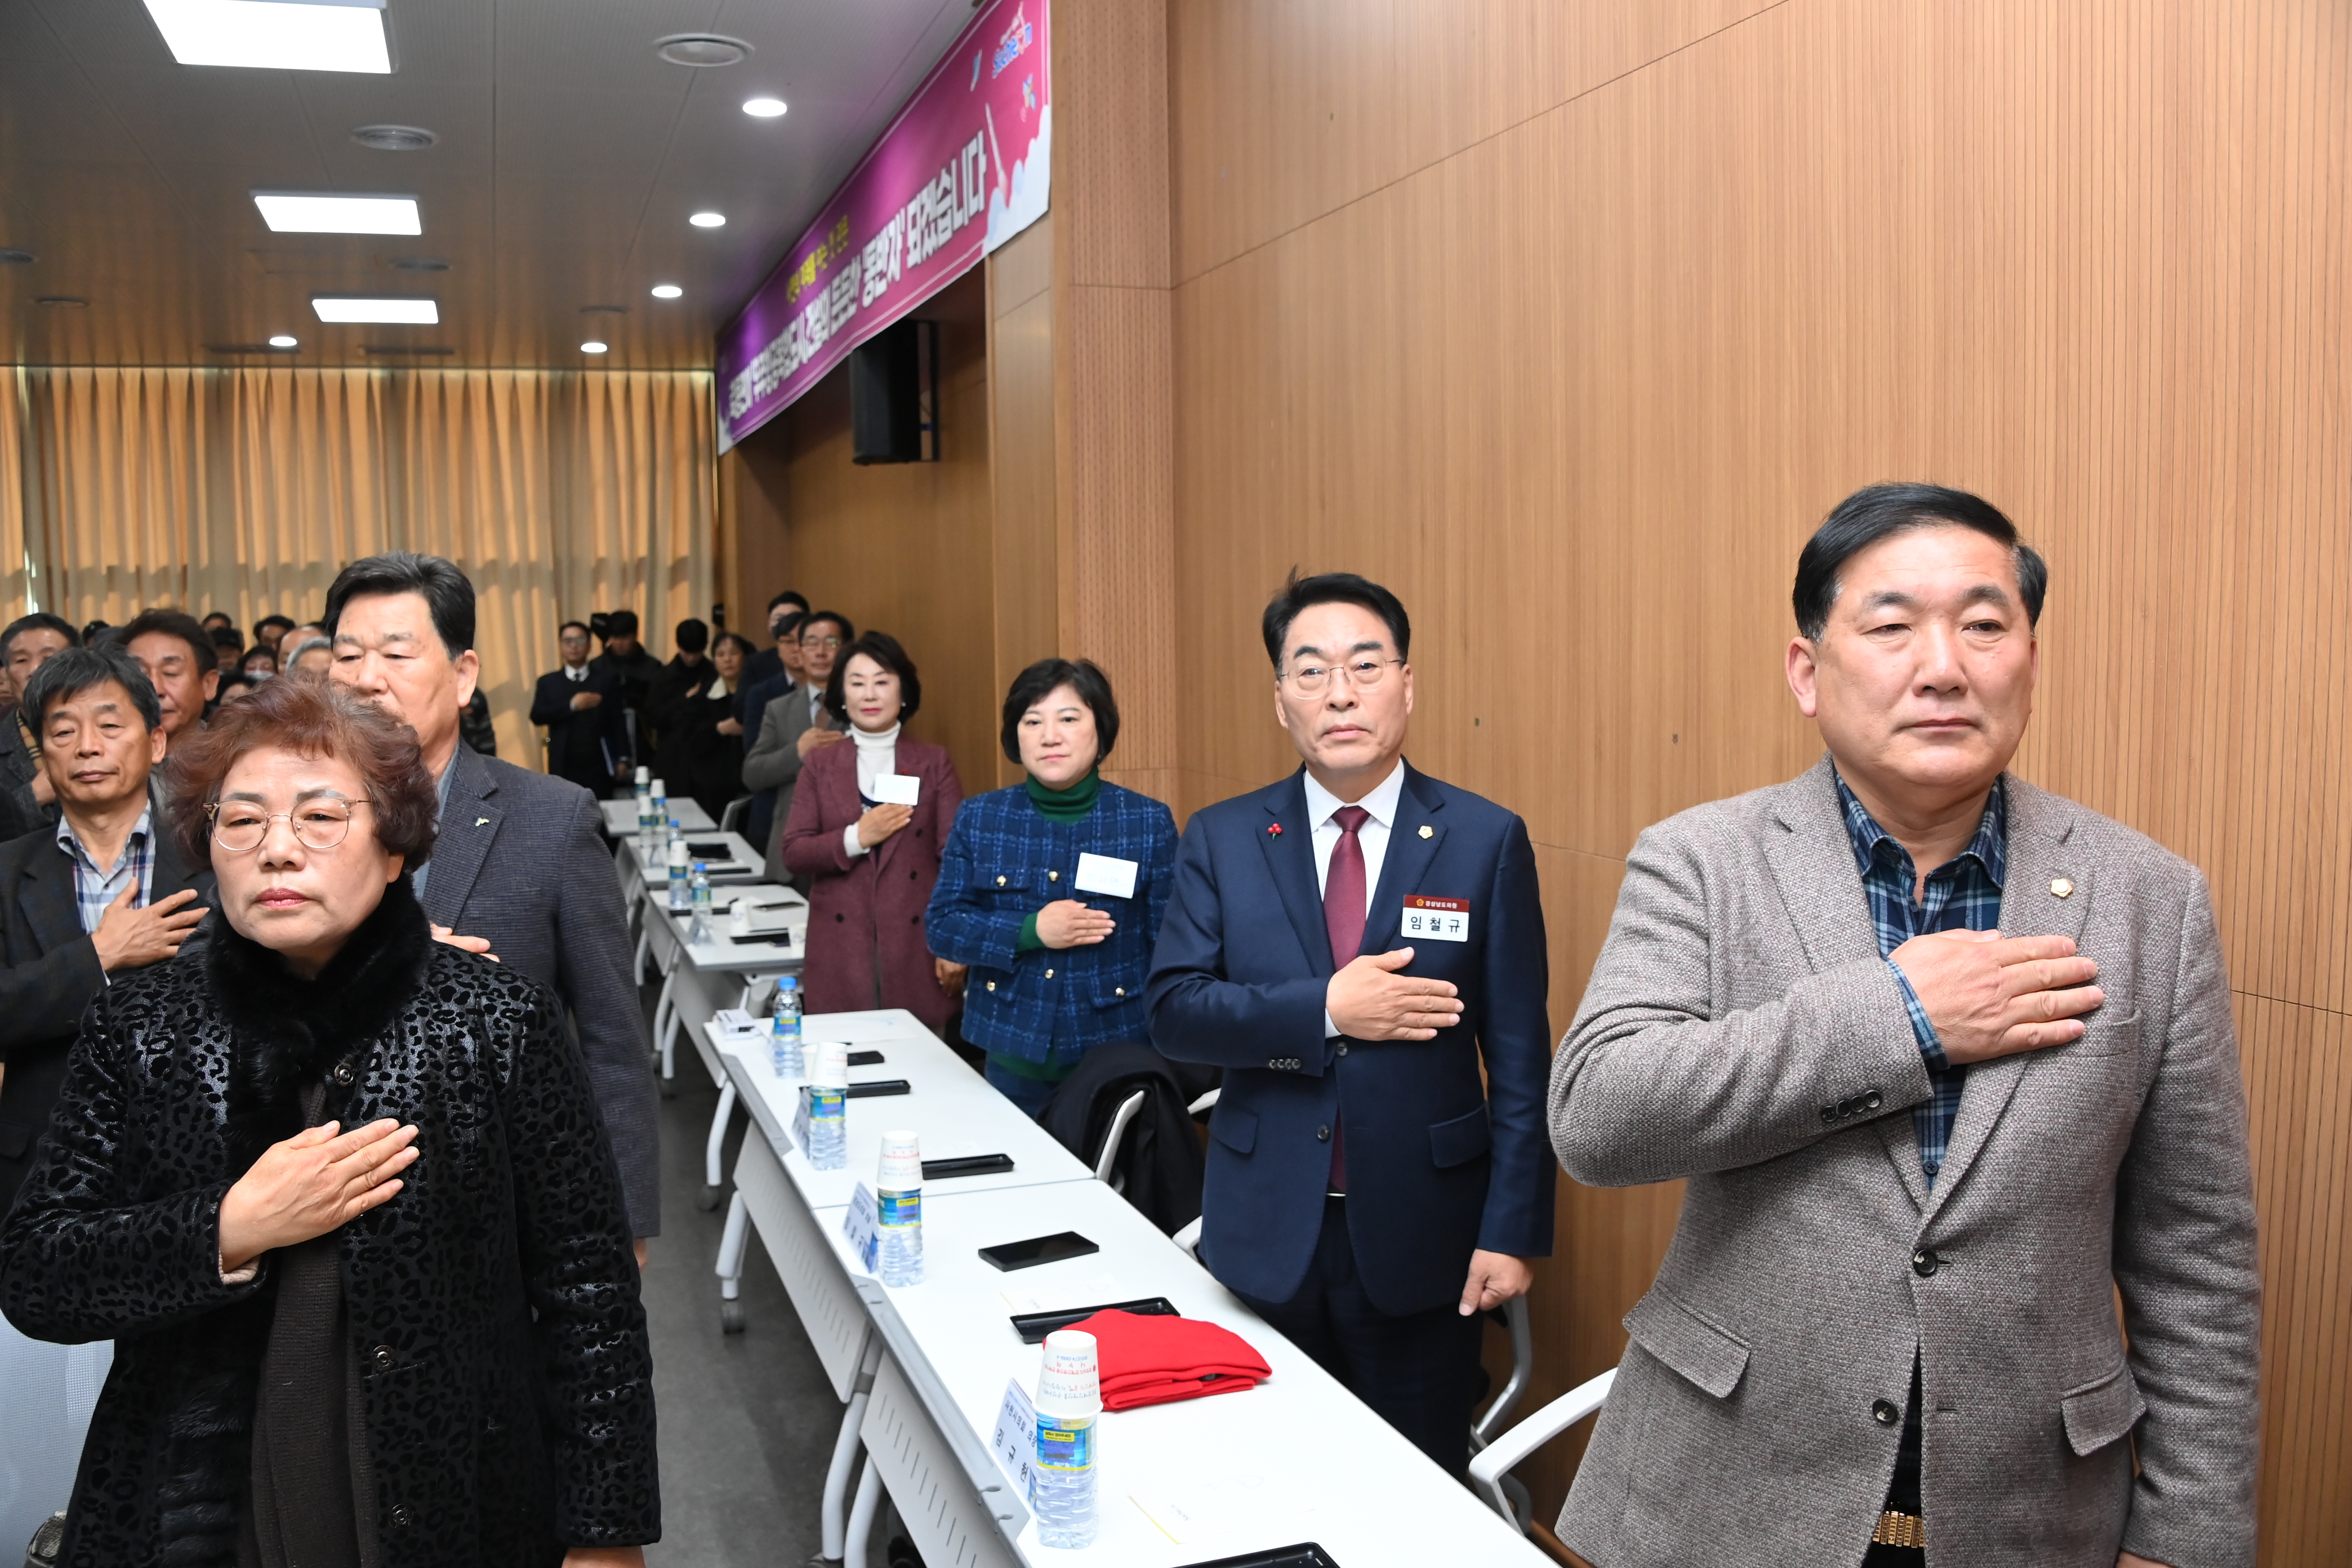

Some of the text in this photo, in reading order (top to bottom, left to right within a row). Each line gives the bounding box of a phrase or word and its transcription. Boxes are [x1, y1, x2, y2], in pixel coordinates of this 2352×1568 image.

[907, 129, 987, 269] 되겠습니다
[1411, 916, 1460, 933] 임 철 규
[1008, 1444, 1016, 1464] 규
